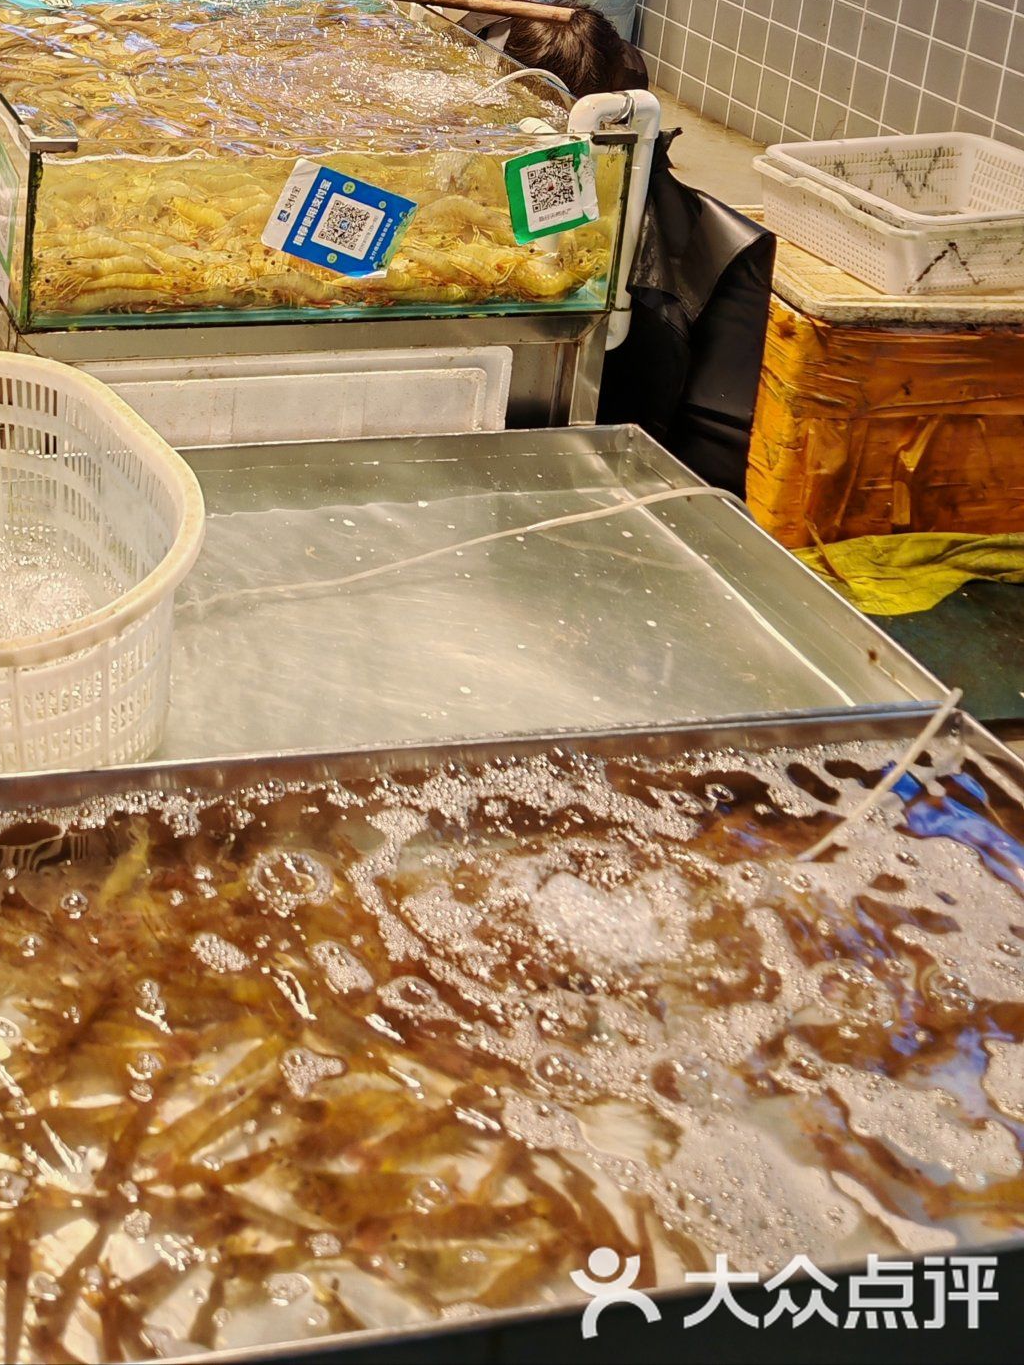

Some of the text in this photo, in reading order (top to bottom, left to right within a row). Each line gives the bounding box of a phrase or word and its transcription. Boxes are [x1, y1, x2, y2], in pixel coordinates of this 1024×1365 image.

[284, 185, 302, 211] 支付宝
[292, 178, 333, 247] 推荐使用支付宝
